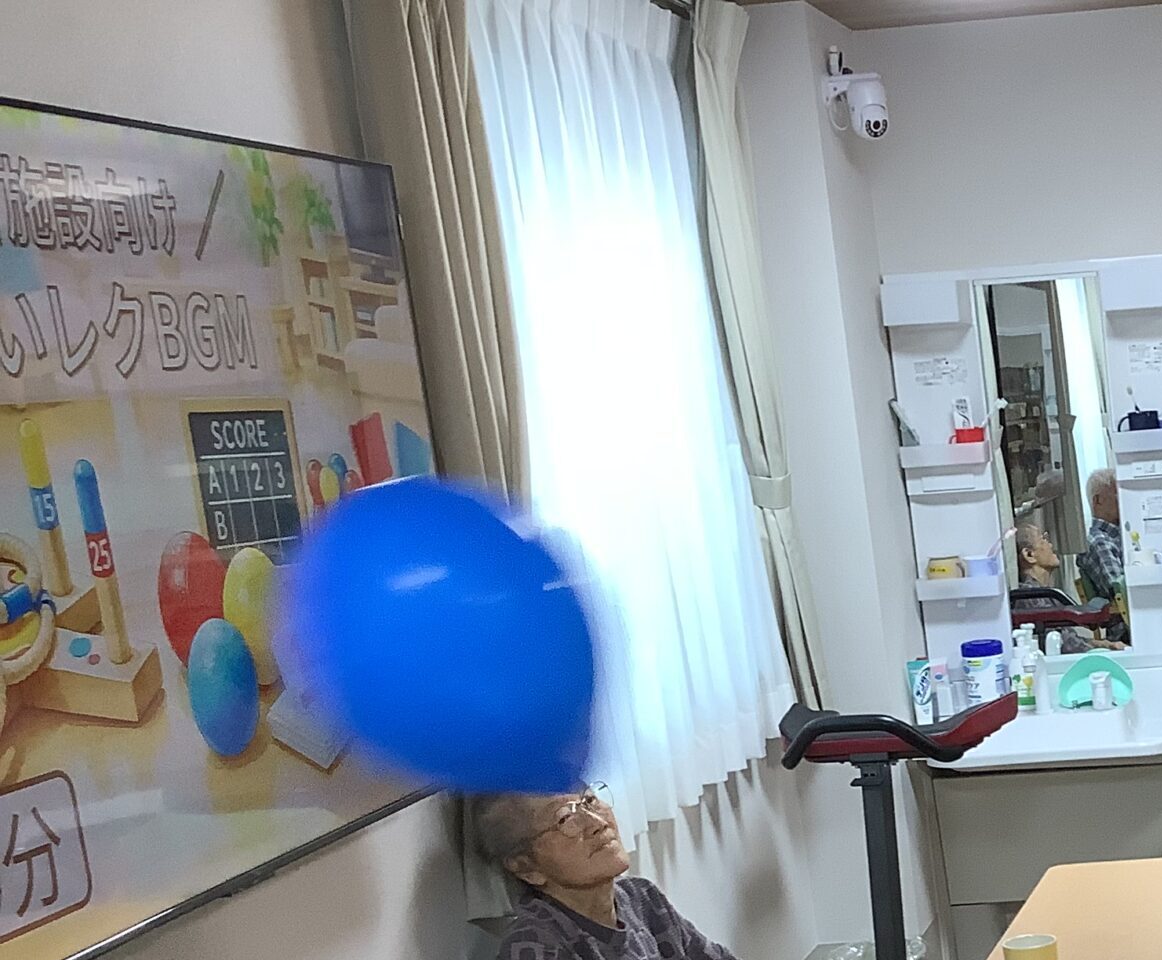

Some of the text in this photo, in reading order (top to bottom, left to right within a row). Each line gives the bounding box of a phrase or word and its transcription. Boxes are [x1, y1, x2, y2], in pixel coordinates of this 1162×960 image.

[210, 419, 269, 450] SCORE
[207, 461, 287, 494] A 1 2 3
[35, 494, 56, 523] 15
[214, 510, 229, 540] B
[88, 539, 112, 572] 25
